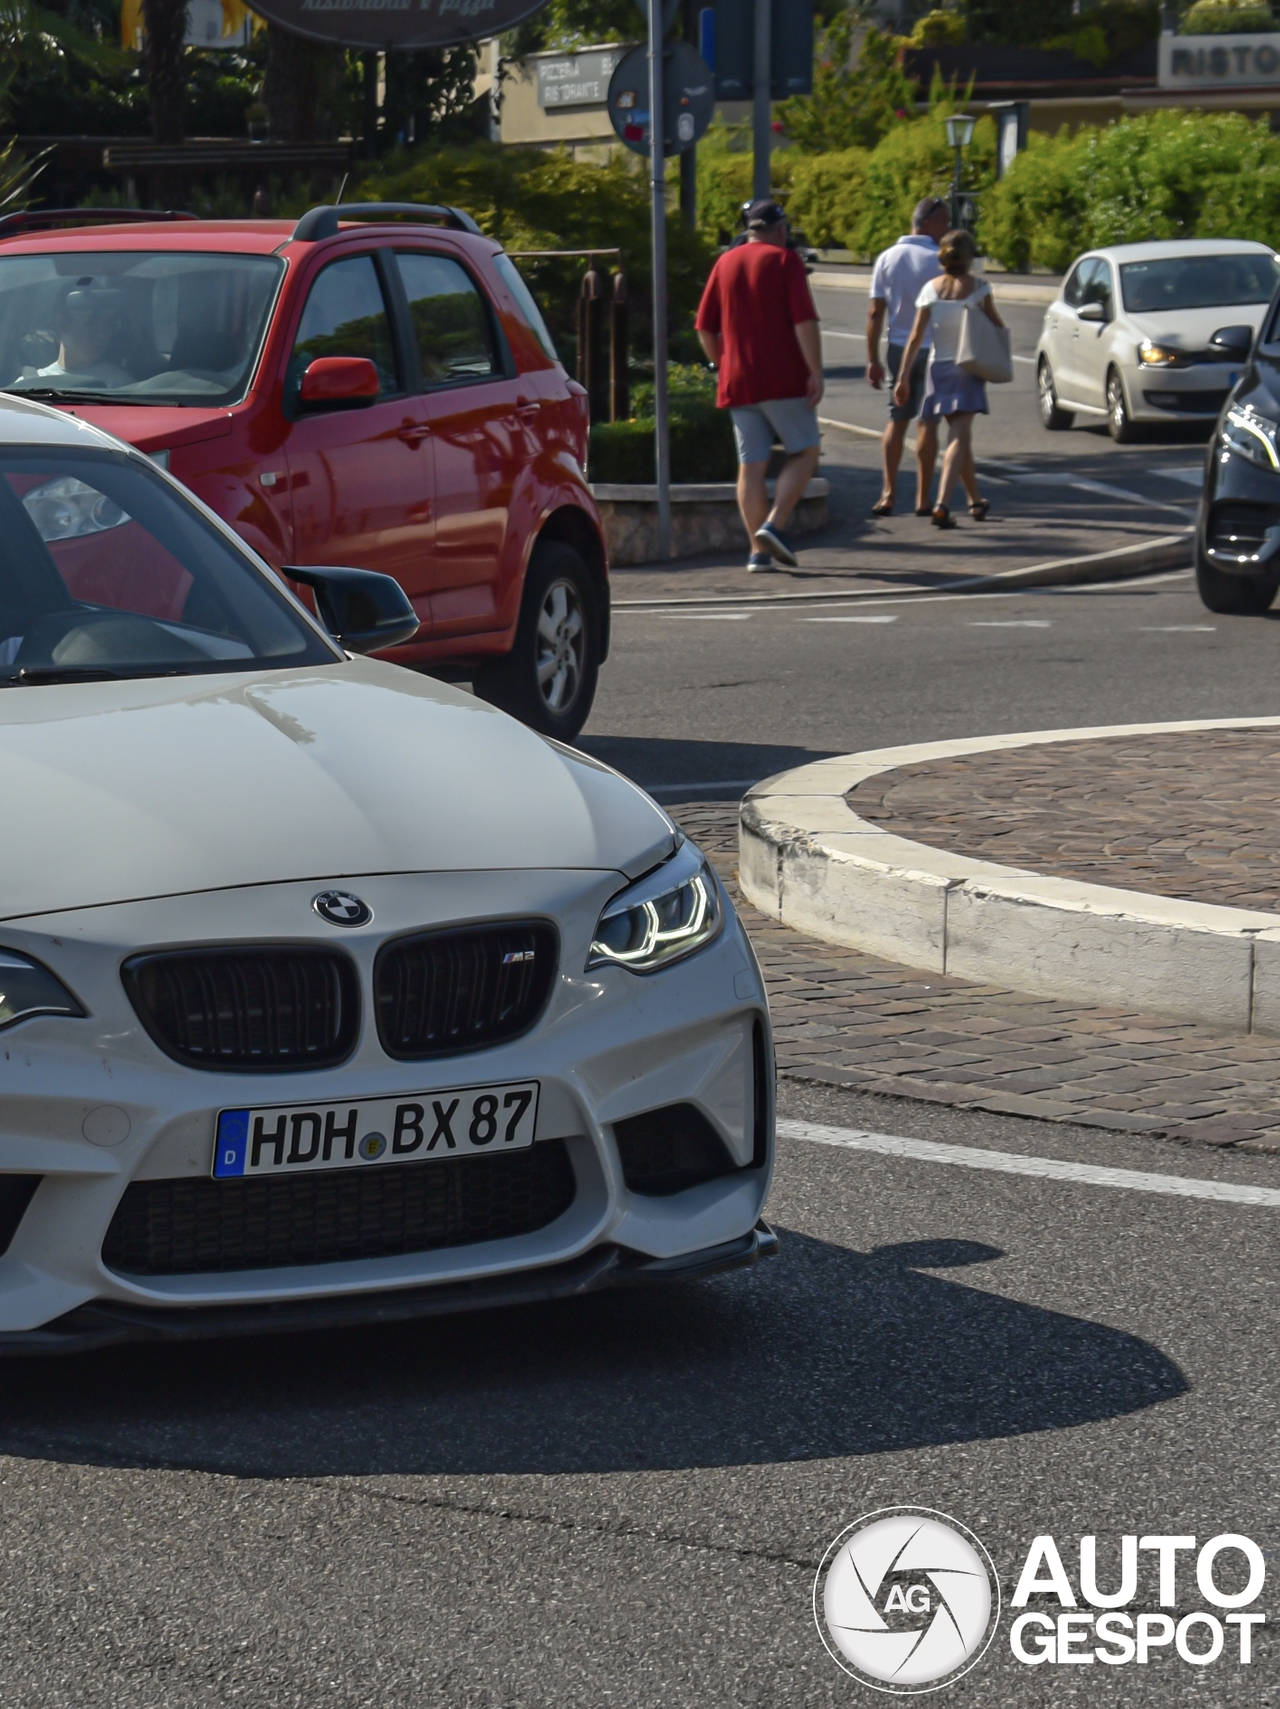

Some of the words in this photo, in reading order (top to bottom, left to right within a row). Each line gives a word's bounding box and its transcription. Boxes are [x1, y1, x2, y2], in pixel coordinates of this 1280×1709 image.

[1171, 44, 1280, 77] RISTO
[540, 61, 580, 81] PIZZERIA
[545, 81, 600, 101] RISTORANTE
[317, 891, 360, 904] BMW
[250, 1109, 358, 1167] HDH
[391, 1098, 460, 1155] BX
[468, 1089, 533, 1146] 87
[224, 1150, 236, 1165] D
